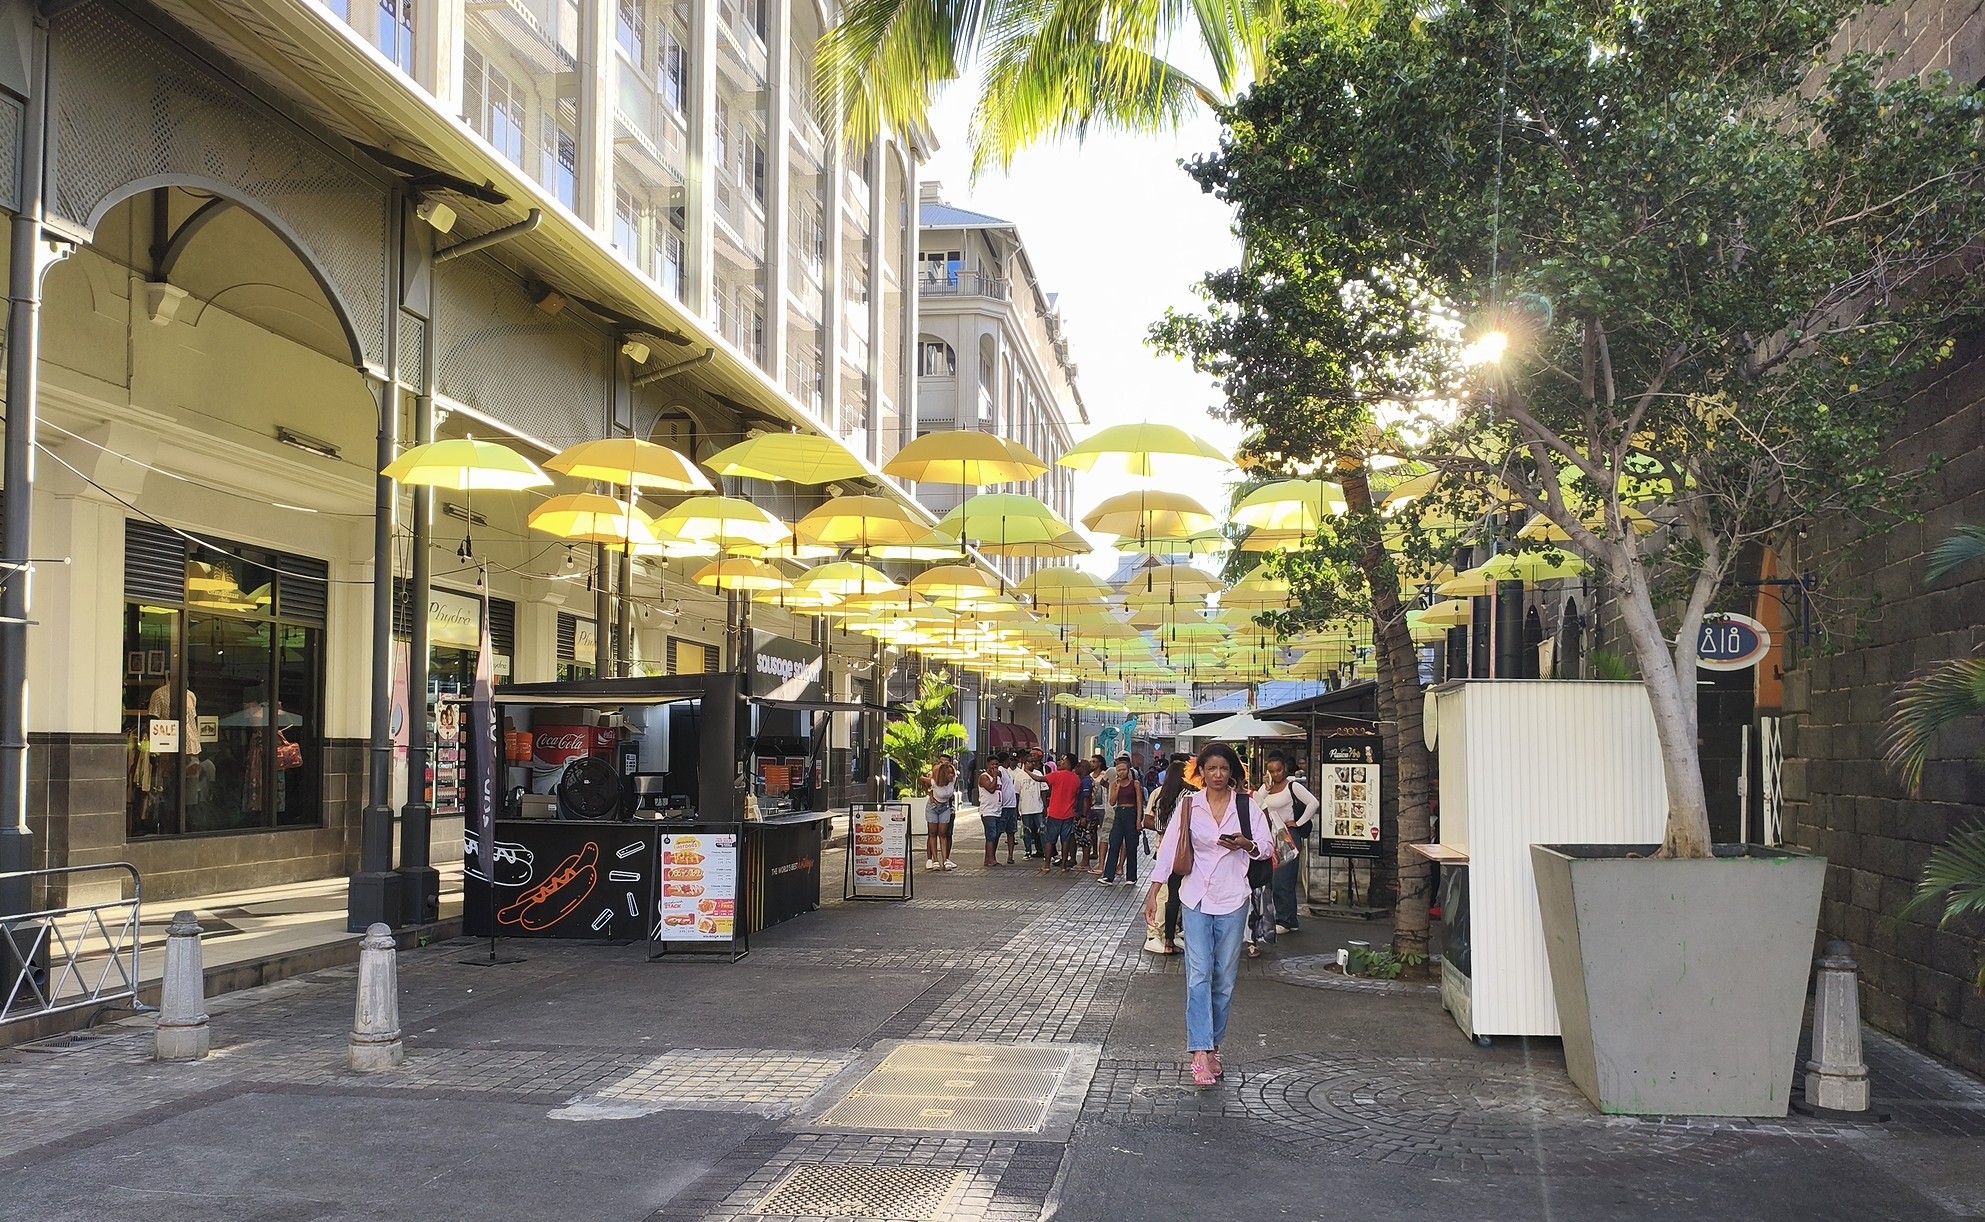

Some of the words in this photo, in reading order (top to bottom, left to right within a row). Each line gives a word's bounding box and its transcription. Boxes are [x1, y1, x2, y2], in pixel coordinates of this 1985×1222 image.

[756, 653, 794, 684] sausage
[793, 658, 820, 683] saloon
[152, 723, 177, 736] SALE
[536, 732, 586, 750] Coca-Cola
